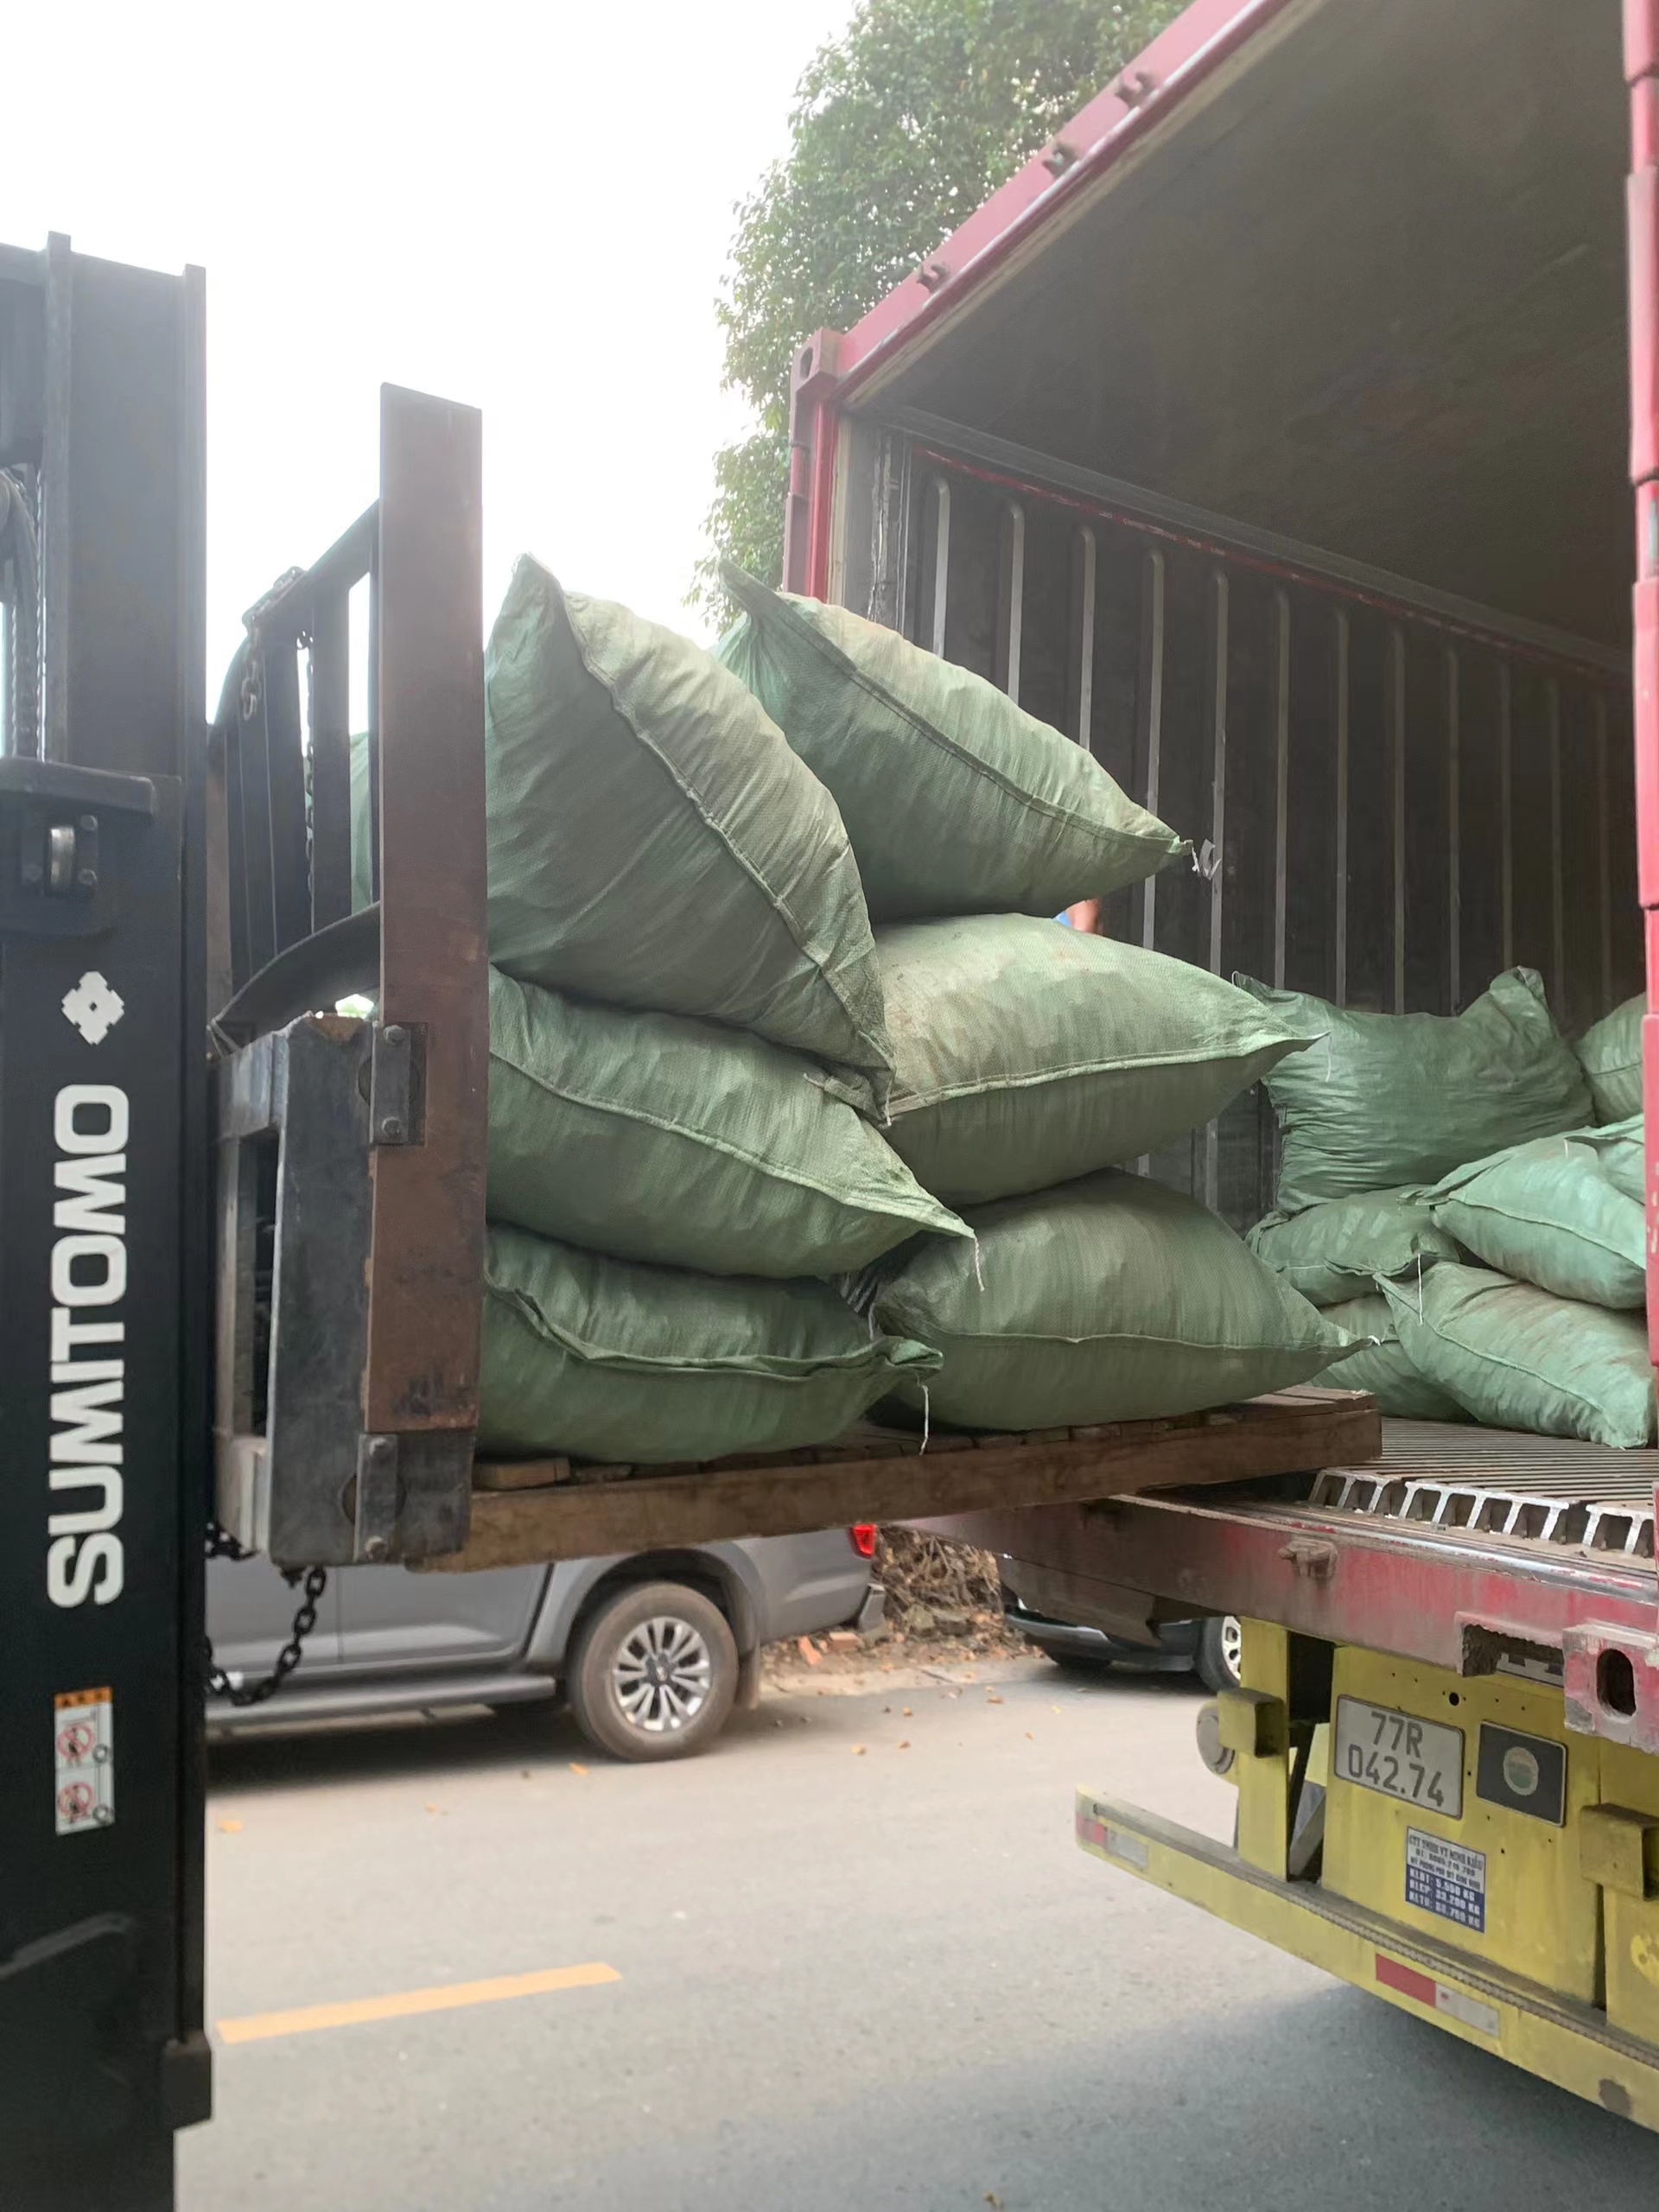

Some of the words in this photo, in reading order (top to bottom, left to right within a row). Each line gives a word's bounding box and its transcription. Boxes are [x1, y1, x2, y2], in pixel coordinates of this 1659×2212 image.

[47, 1084, 129, 1608] SUMITOMO
[1371, 1711, 1423, 1759] 77R
[1349, 1744, 1444, 1807] 042.74
[1463, 1888, 1475, 1902] KG
[1468, 1902, 1480, 1916] KG
